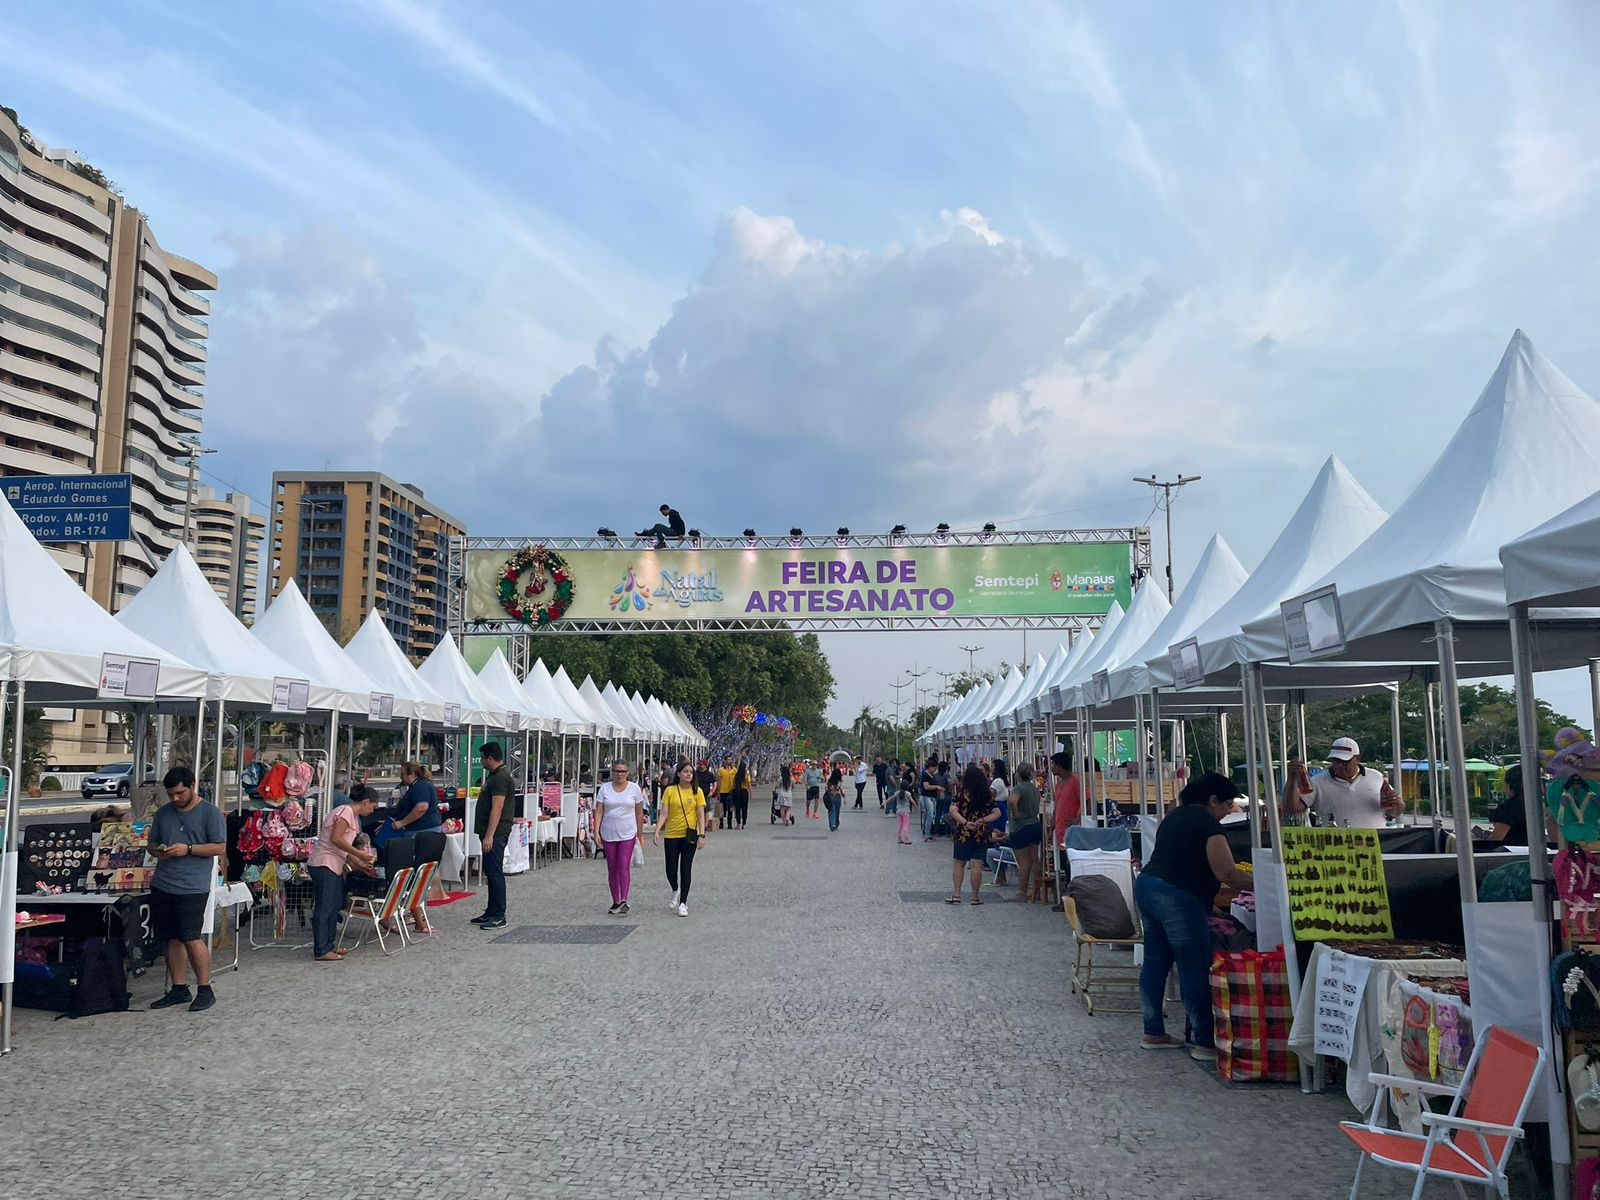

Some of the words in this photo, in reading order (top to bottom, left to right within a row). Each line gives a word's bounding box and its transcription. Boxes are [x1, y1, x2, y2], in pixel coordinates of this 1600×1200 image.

[24, 481, 57, 492] Aerop.
[60, 479, 127, 490] Internacional
[23, 495, 66, 504] Eduardo
[71, 493, 108, 503] Gomes
[22, 514, 60, 523] Rodov.
[65, 512, 109, 523] AM-010
[28, 527, 59, 537] odov.
[64, 526, 107, 536] BR-174
[660, 568, 717, 589] Natal
[782, 561, 870, 584] FEIRA
[876, 560, 916, 583] DE
[974, 573, 1040, 589] Semtepi
[1066, 574, 1116, 585] Manaus
[744, 588, 955, 613] ARTESANATO
